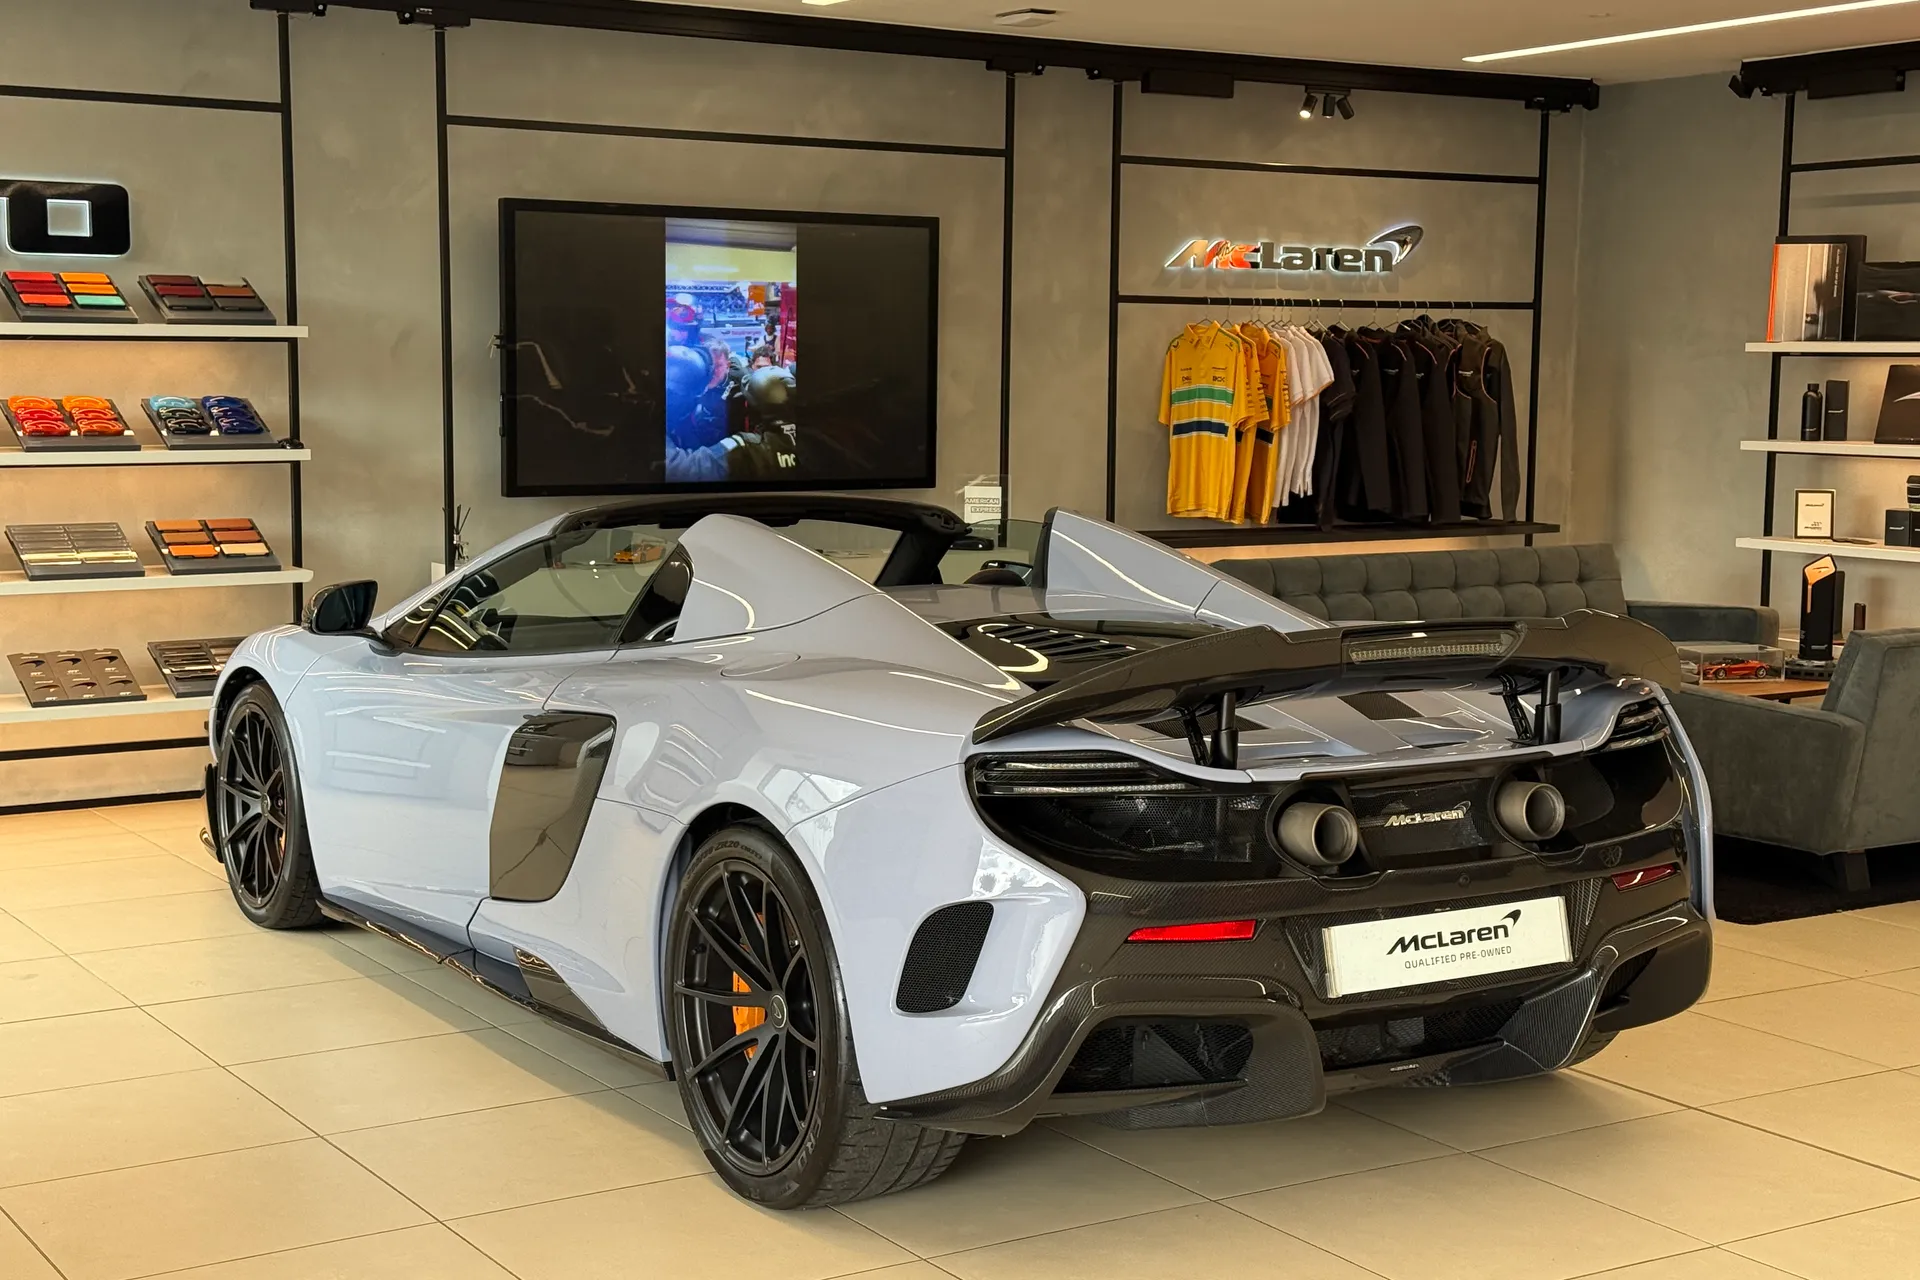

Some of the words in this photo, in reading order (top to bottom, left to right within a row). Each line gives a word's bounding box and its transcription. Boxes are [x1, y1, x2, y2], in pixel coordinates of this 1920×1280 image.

[1164, 239, 1394, 272] McLaren
[1384, 810, 1465, 827] McLaren
[1386, 923, 1509, 955] McLaren
[1404, 954, 1457, 969] QUALIFIED
[1460, 945, 1512, 961] PRE-OWNED
